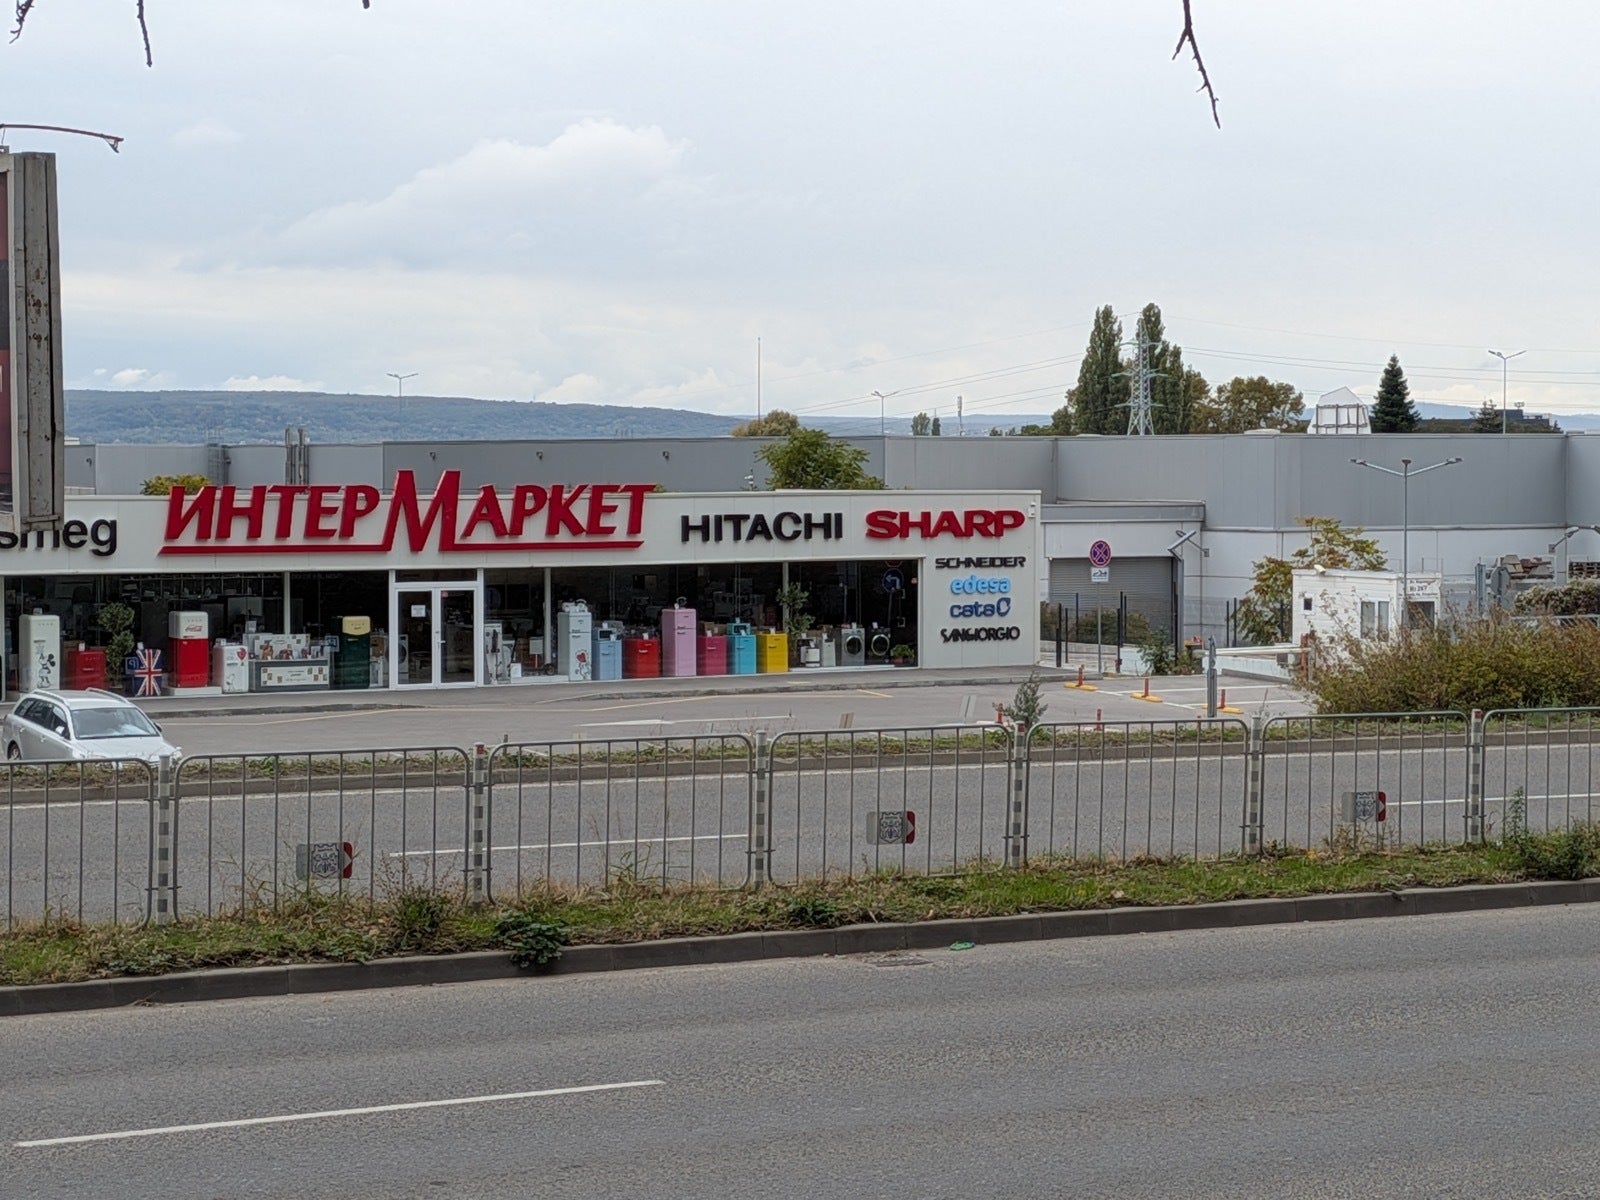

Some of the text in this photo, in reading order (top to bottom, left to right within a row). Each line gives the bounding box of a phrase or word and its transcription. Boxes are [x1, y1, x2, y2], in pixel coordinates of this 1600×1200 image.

[681, 512, 843, 542] HITACHI
[866, 510, 1026, 538] SHARP
[935, 556, 1026, 569] SCHNEIDER
[950, 575, 1011, 594] edesa
[949, 601, 996, 618] cata
